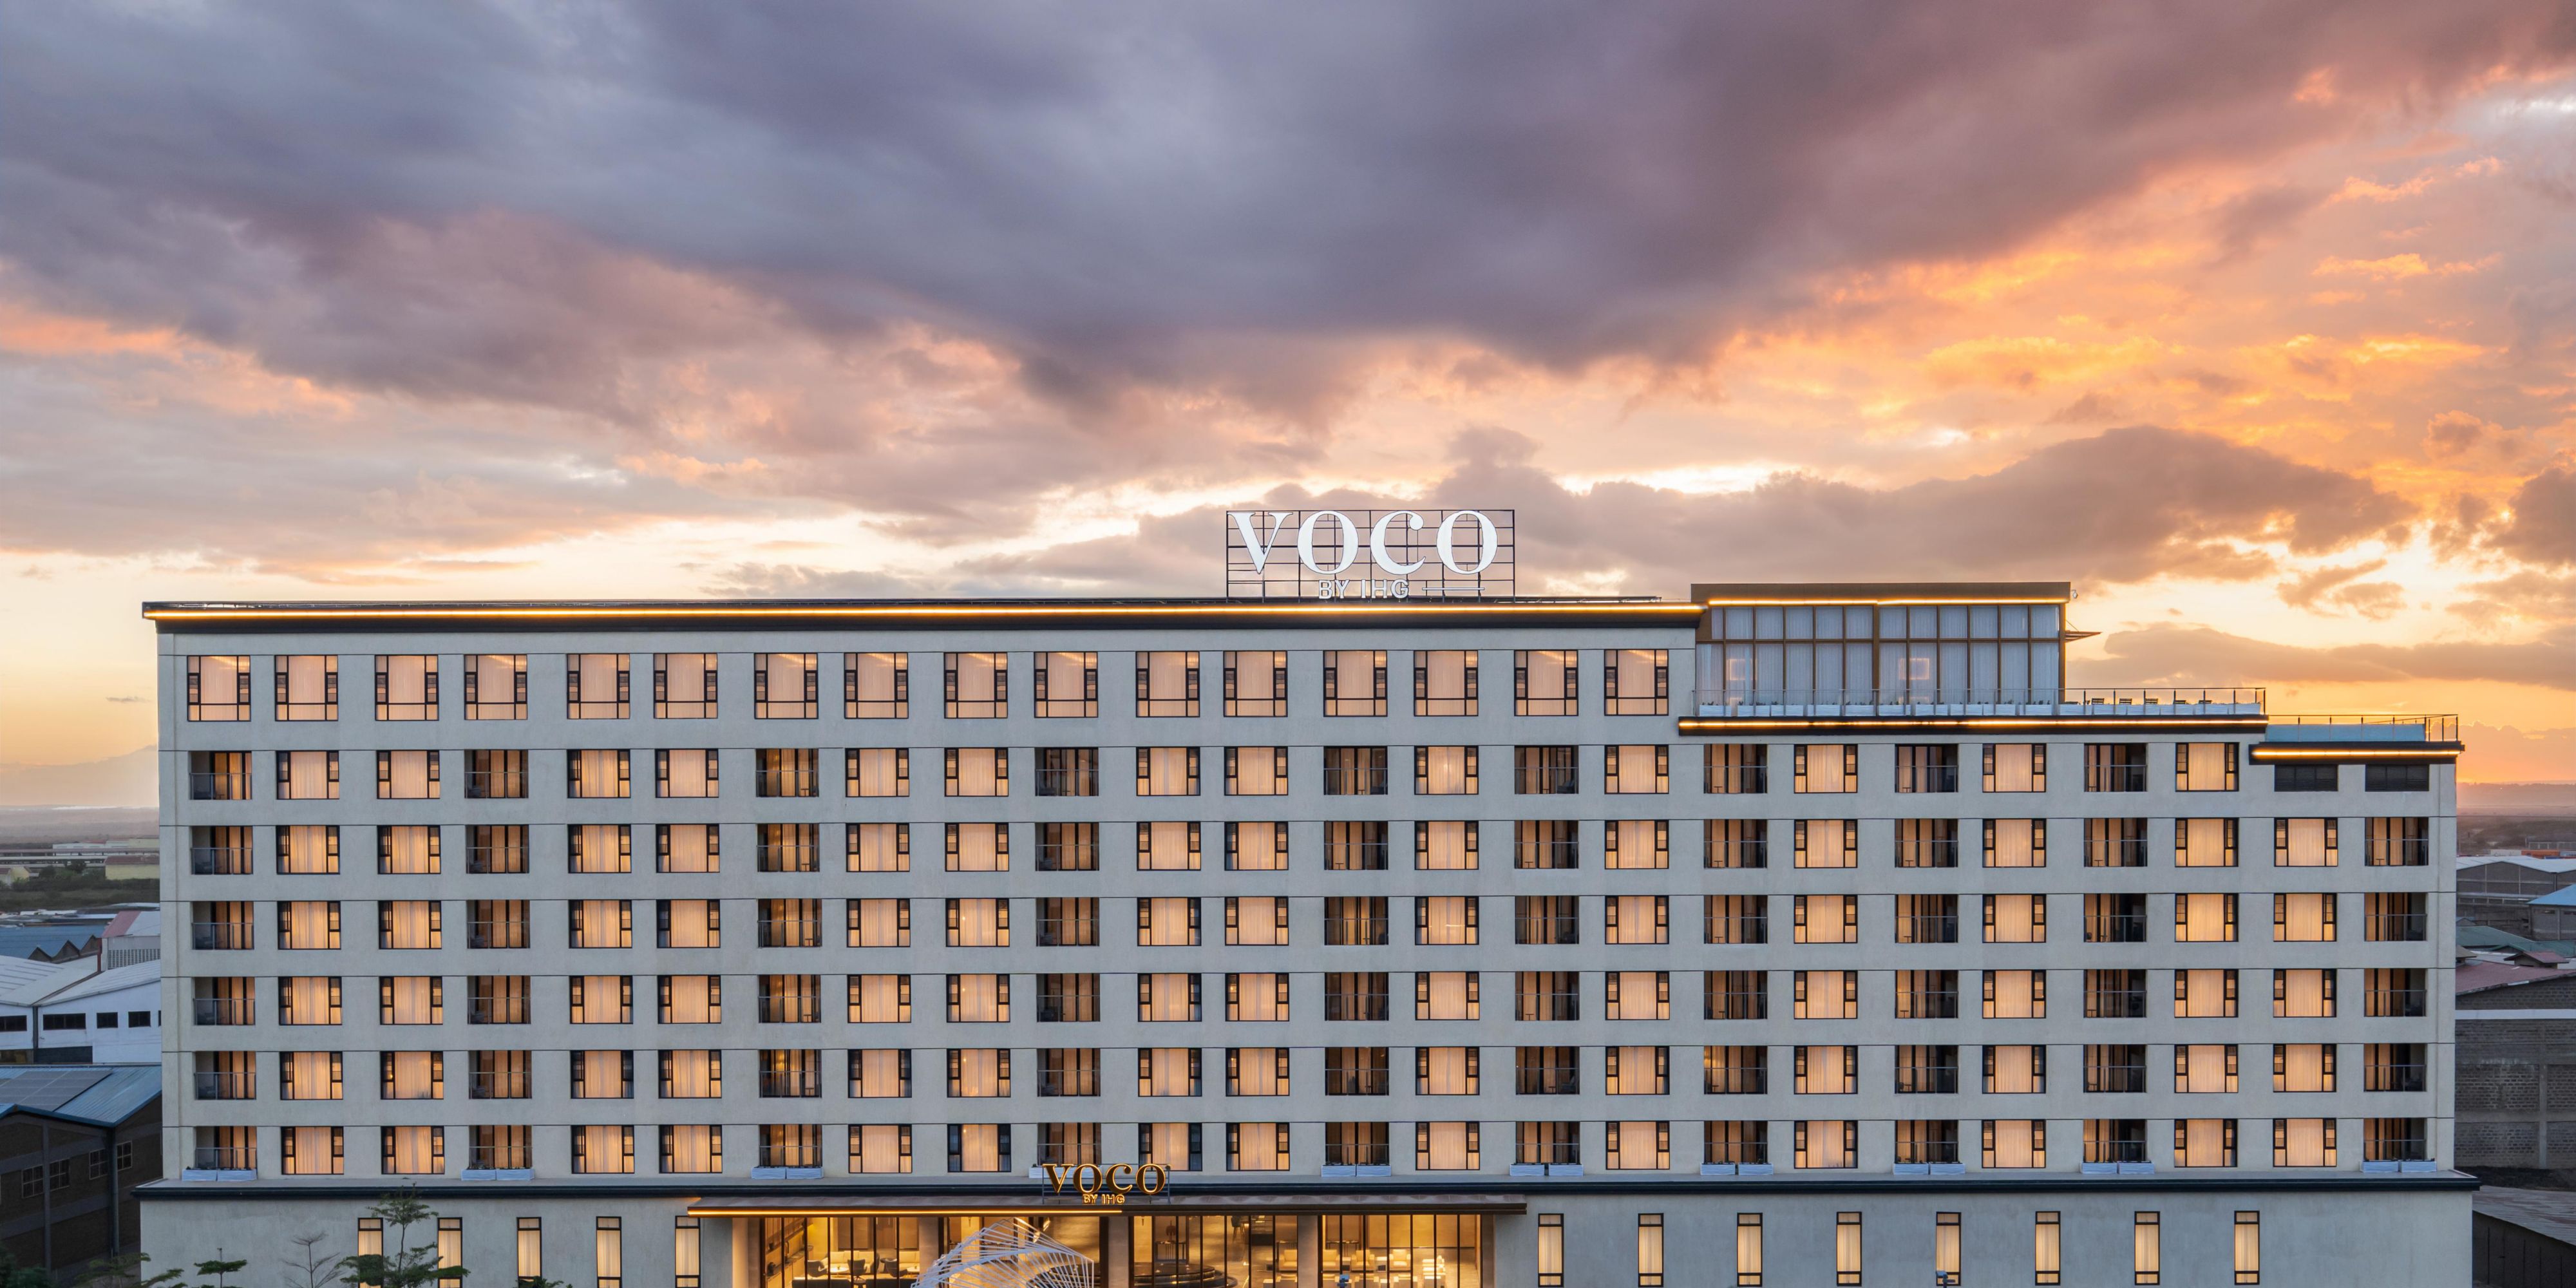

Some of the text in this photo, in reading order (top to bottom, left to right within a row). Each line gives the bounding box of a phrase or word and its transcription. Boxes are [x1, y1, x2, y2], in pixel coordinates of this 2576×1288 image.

[1318, 579, 1410, 600] BY IHG
[1083, 1194, 1125, 1204] BY IHG
